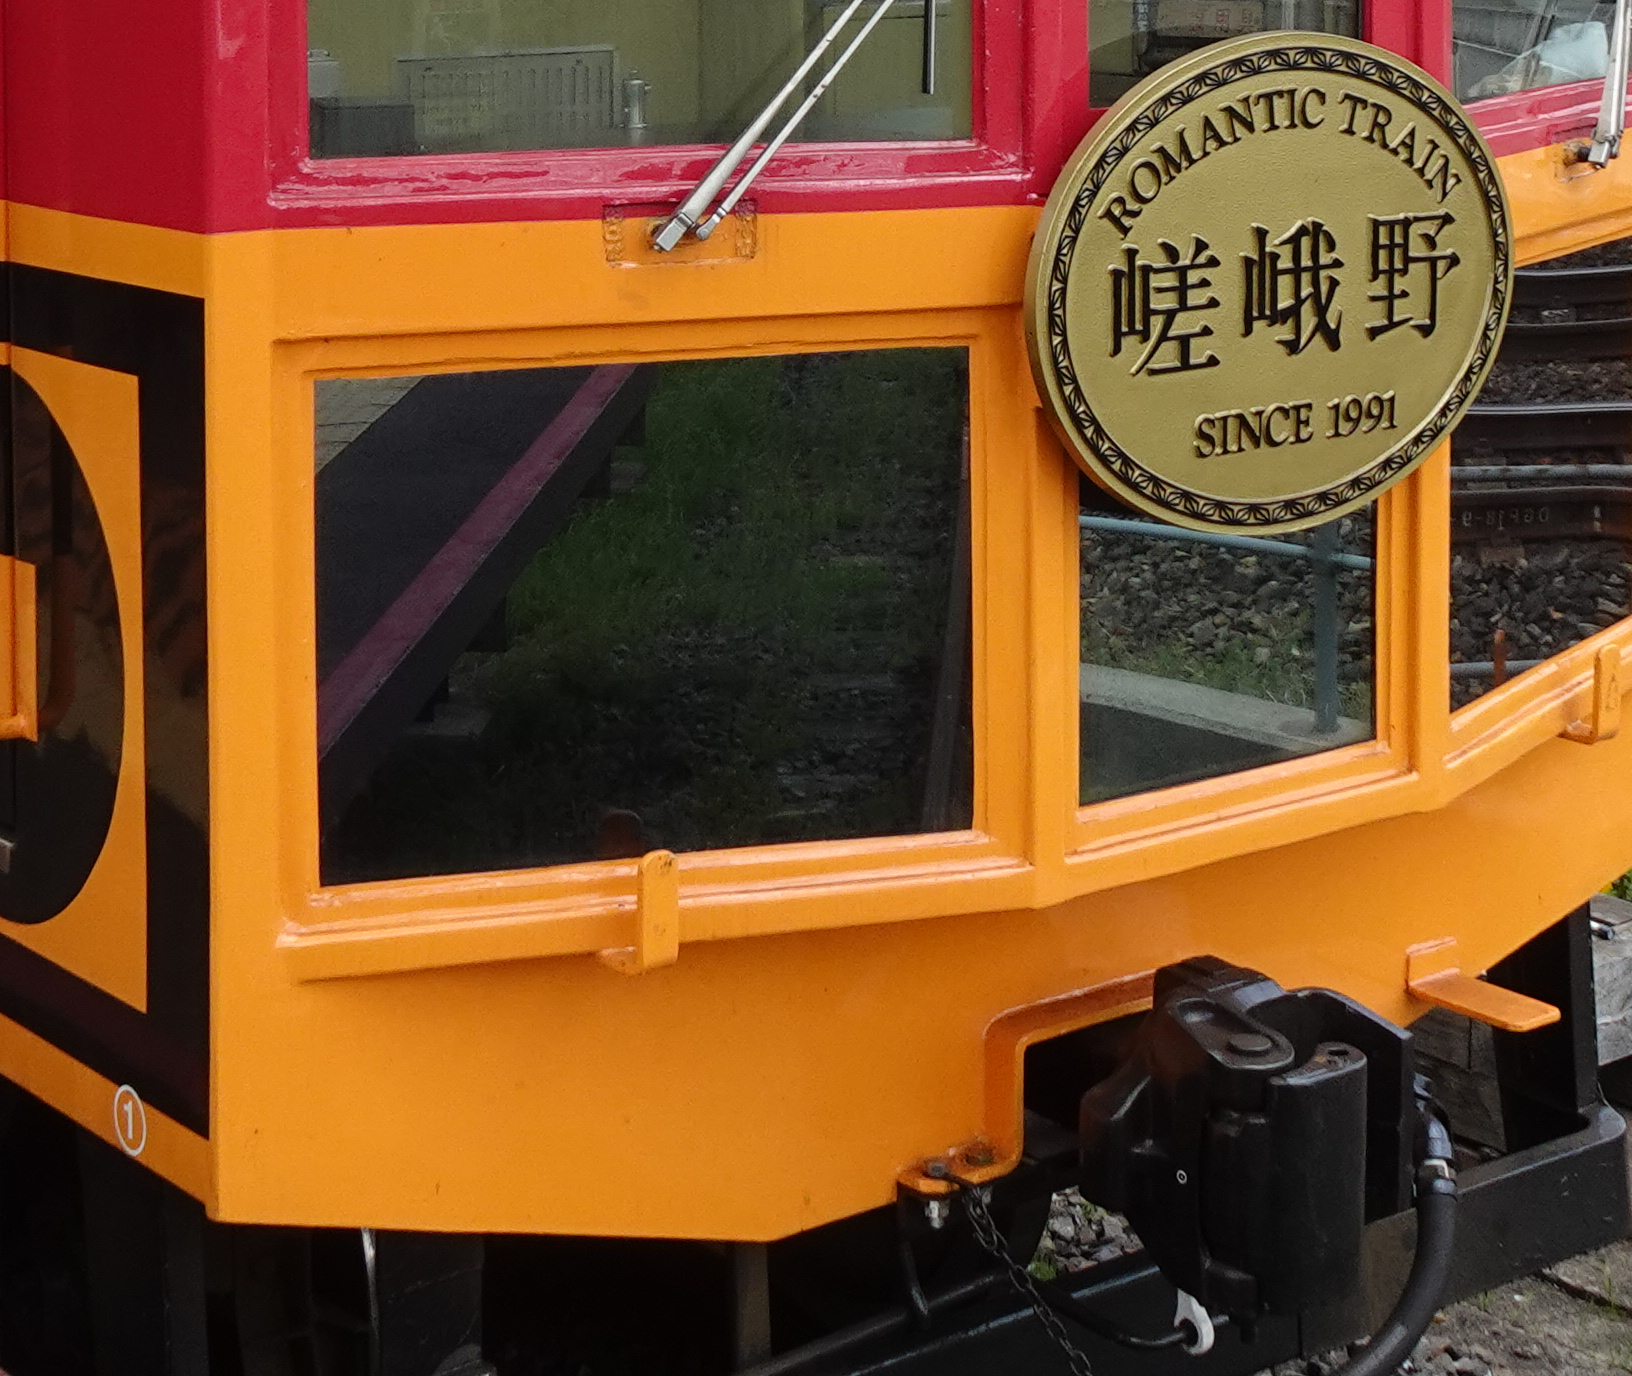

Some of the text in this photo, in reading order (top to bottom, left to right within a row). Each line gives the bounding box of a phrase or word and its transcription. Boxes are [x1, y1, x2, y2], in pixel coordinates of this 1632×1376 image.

[1097, 87, 1463, 239] ROMANTIC TRAIN
[1108, 210, 1461, 377] 嵯峨野
[1193, 389, 1398, 459] SINCE 1991
